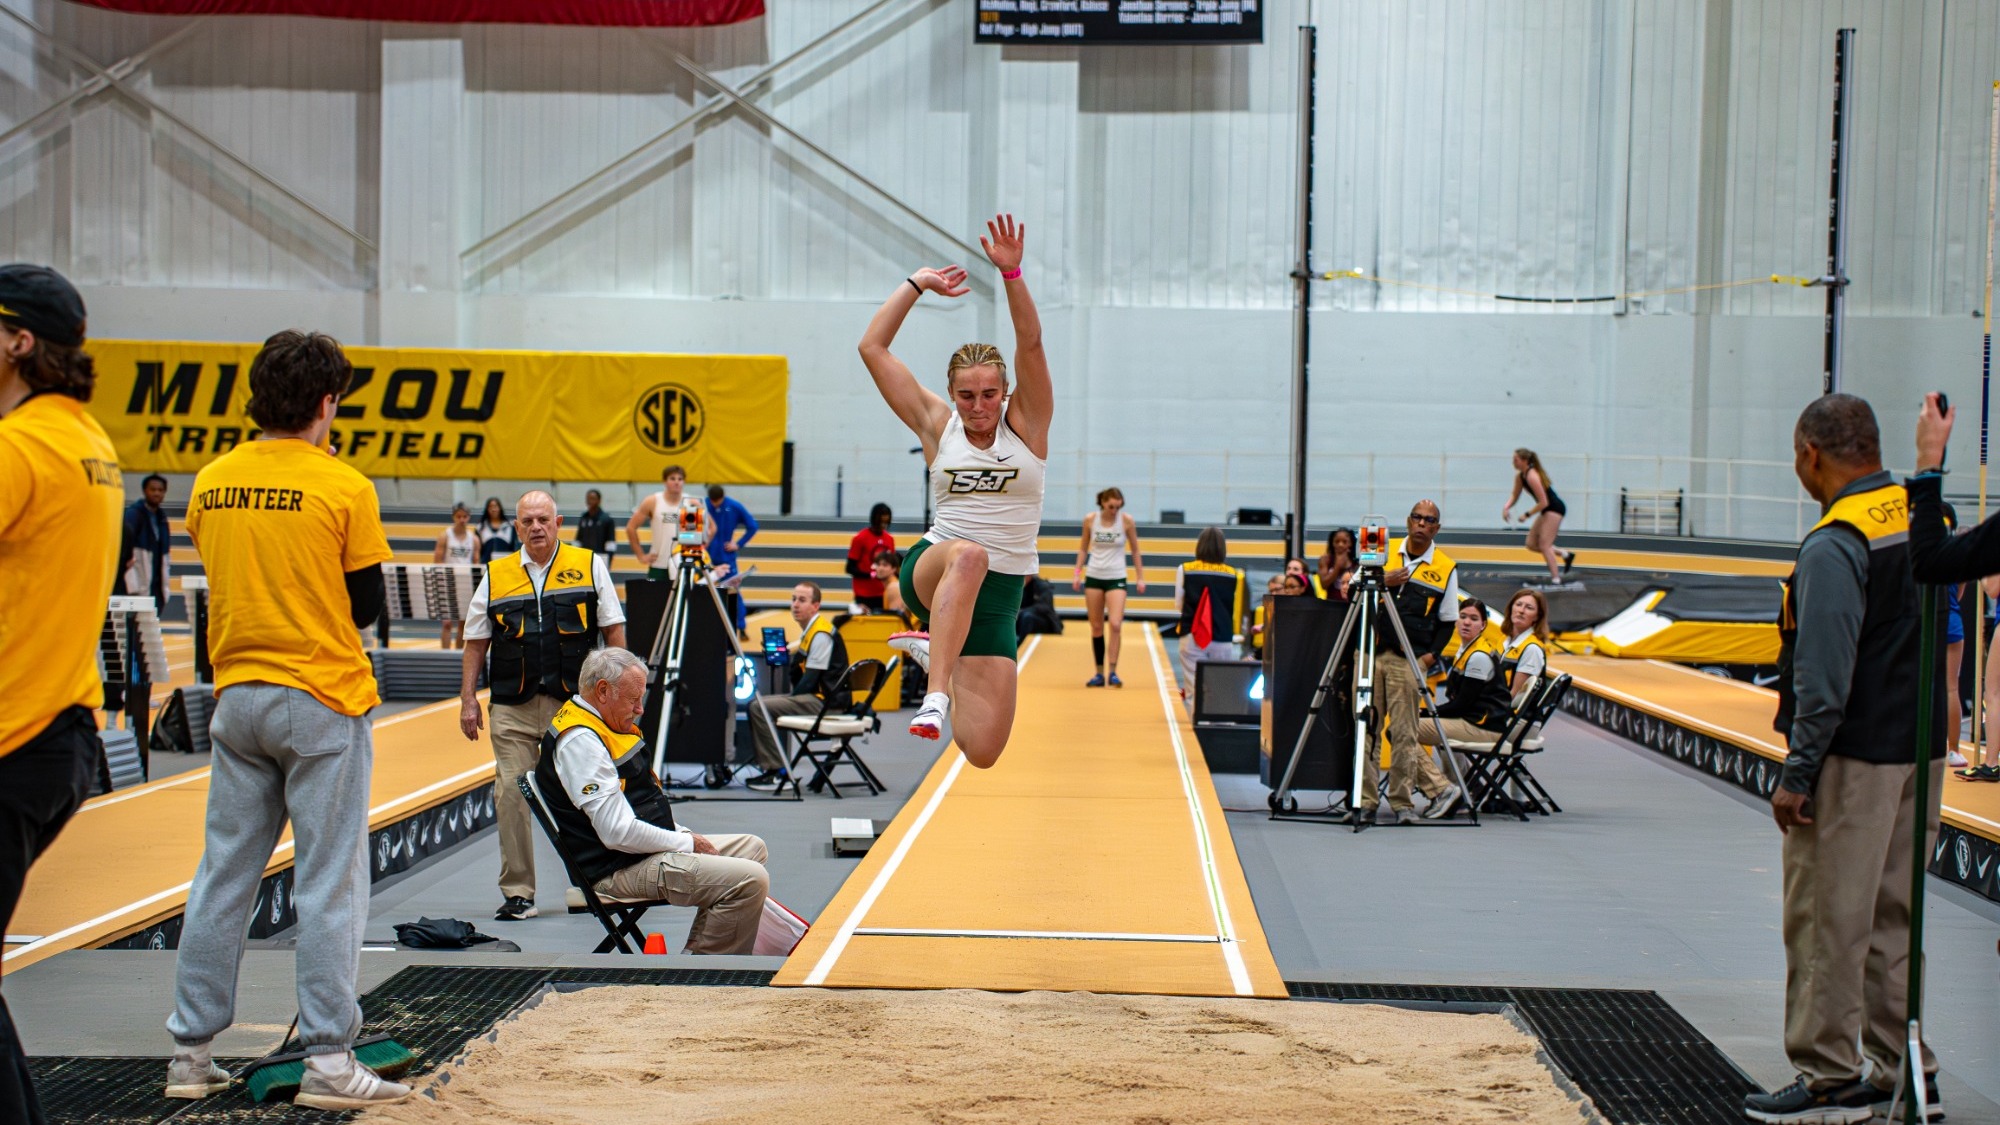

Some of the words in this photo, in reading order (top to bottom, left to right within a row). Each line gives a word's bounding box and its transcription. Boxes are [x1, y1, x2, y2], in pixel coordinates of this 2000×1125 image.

[126, 361, 505, 422] MIZOU
[642, 390, 696, 448] SEC
[943, 468, 1019, 494] S&T
